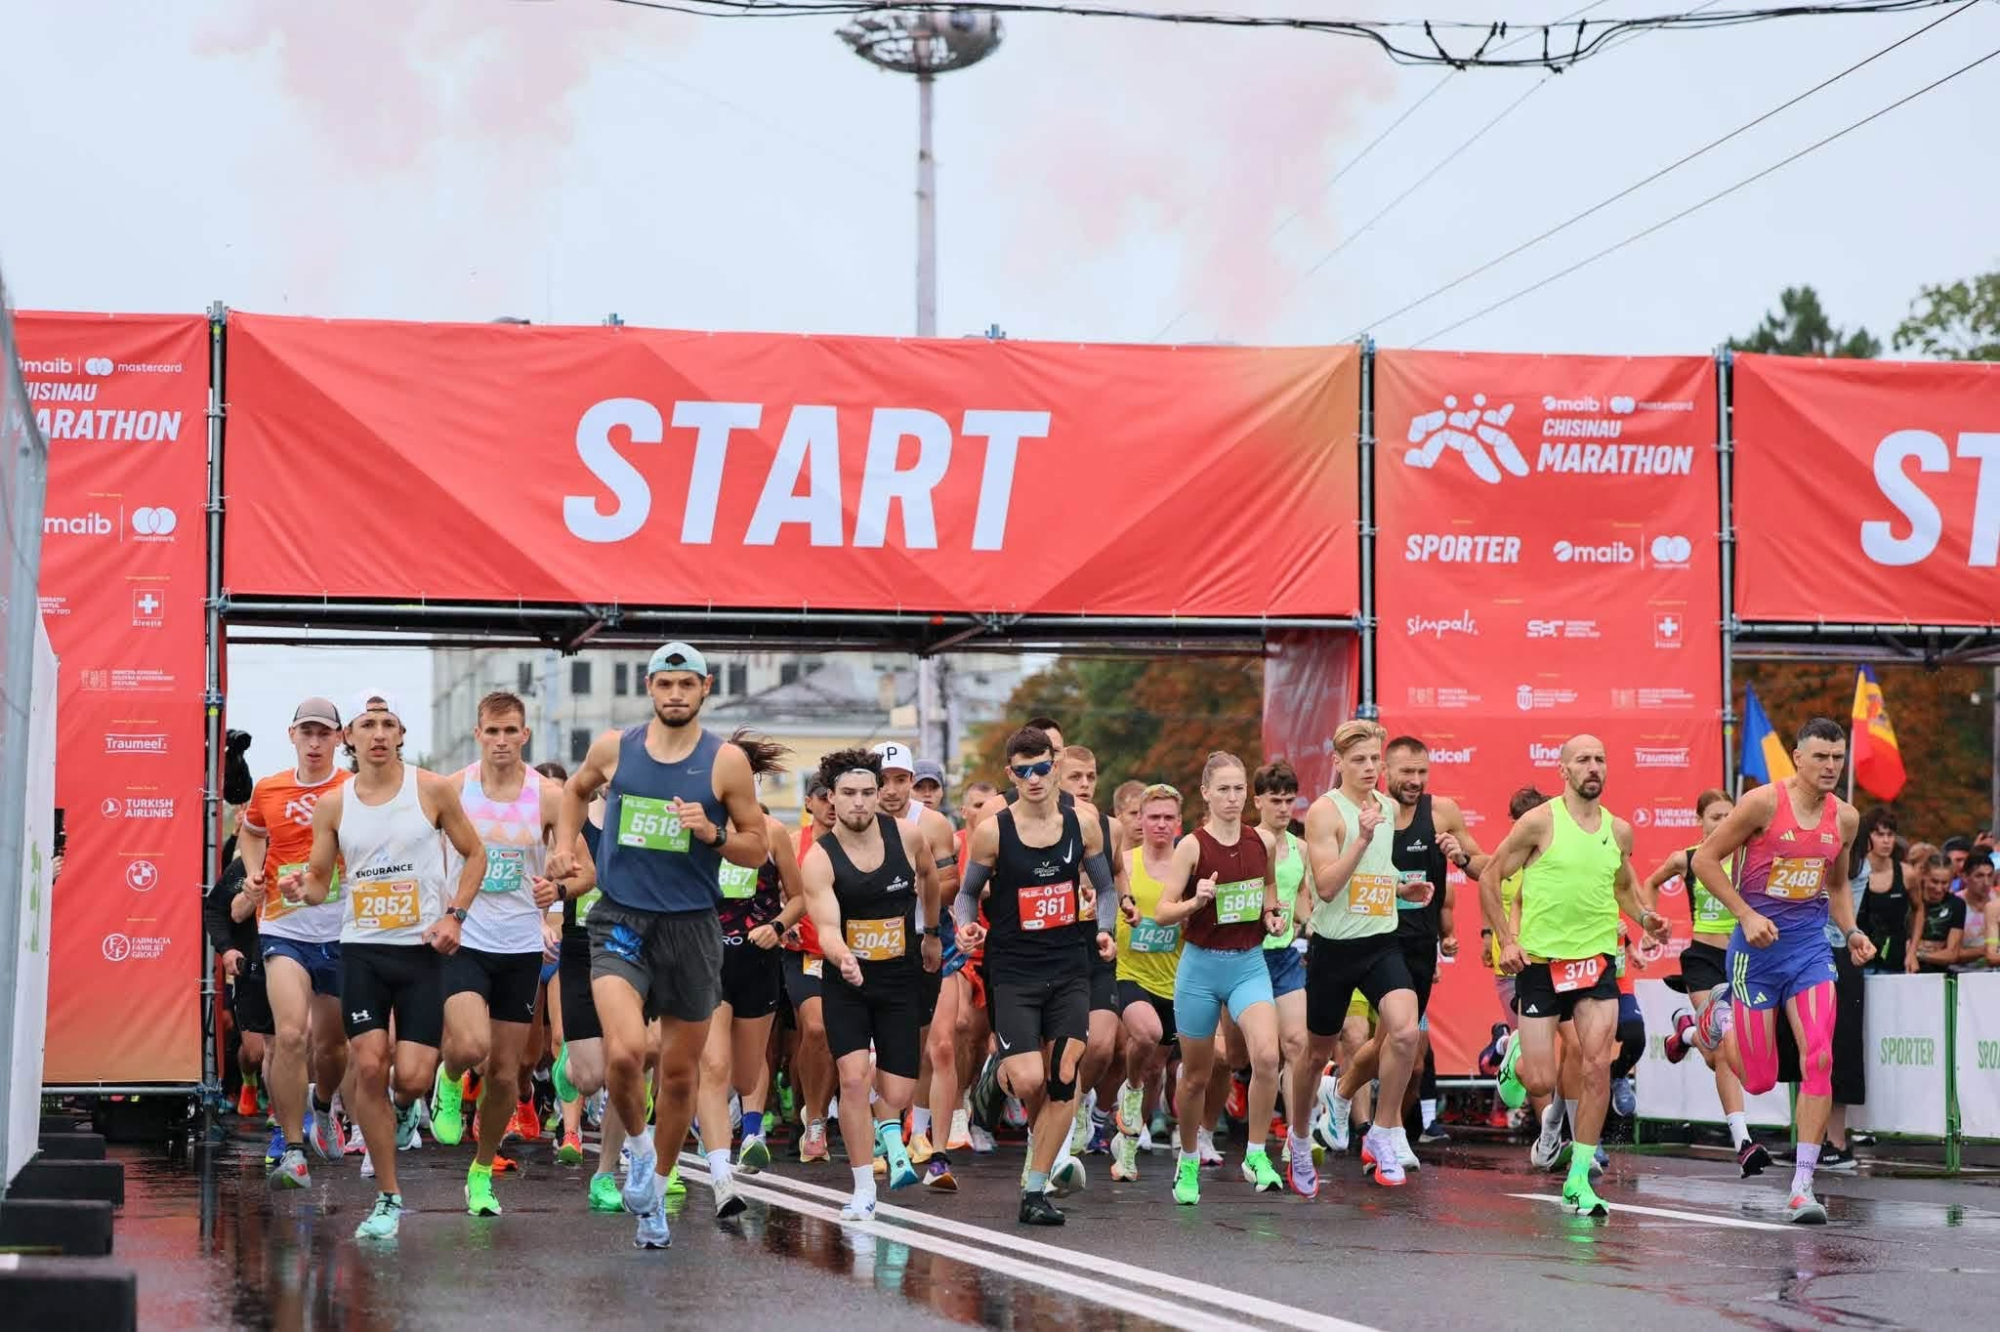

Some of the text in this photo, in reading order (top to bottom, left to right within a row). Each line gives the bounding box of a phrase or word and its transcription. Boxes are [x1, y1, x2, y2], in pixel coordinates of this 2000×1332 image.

[24, 358, 182, 374] maib mastercard
[1556, 396, 1600, 412] maib
[1542, 418, 1622, 438] CHISINAU
[1537, 443, 1694, 475] MARATHON
[562, 397, 1051, 551] START
[1861, 429, 2000, 567] ST
[44, 512, 112, 534] maib
[1405, 534, 1521, 563] SPORTER
[1574, 541, 1635, 563] maib
[105, 737, 162, 749] Traumeel
[887, 746, 898, 761] P
[125, 799, 174, 808] TURKISH
[125, 808, 174, 818] AIRLINES
[1774, 869, 1819, 888] 2488
[1356, 886, 1392, 905] 2437
[361, 895, 413, 917] 2852
[1035, 896, 1066, 918] 361
[853, 930, 901, 949] 3042
[1138, 928, 1174, 944] 1420
[1565, 959, 1598, 980] 370
[1880, 1037, 1935, 1066] SPORTER
